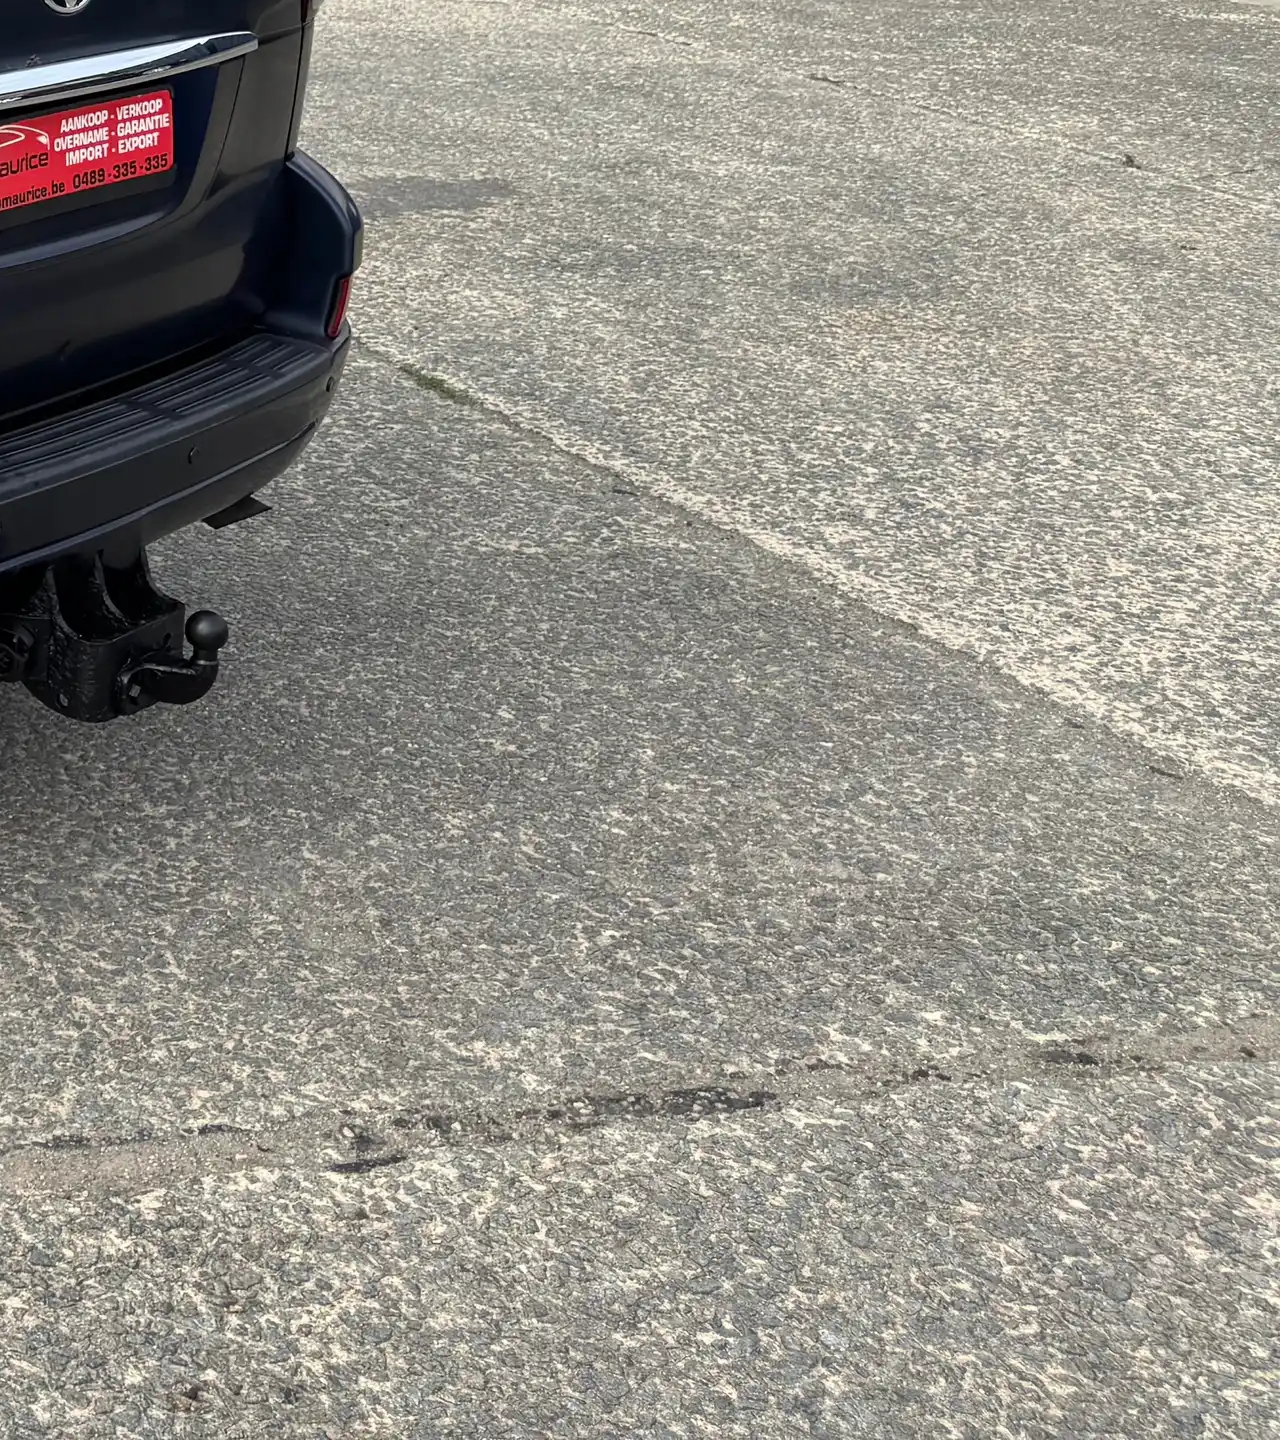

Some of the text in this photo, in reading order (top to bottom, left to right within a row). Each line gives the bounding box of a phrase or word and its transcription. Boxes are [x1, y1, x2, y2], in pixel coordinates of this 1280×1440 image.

[53, 126, 109, 152] OVERNAME
[117, 113, 170, 137] GARANTIE
[60, 109, 109, 133] AANKOOP
[115, 98, 163, 121] VERKOOP
[65, 143, 109, 167] IMPORT
[118, 132, 160, 154] EXPORT
